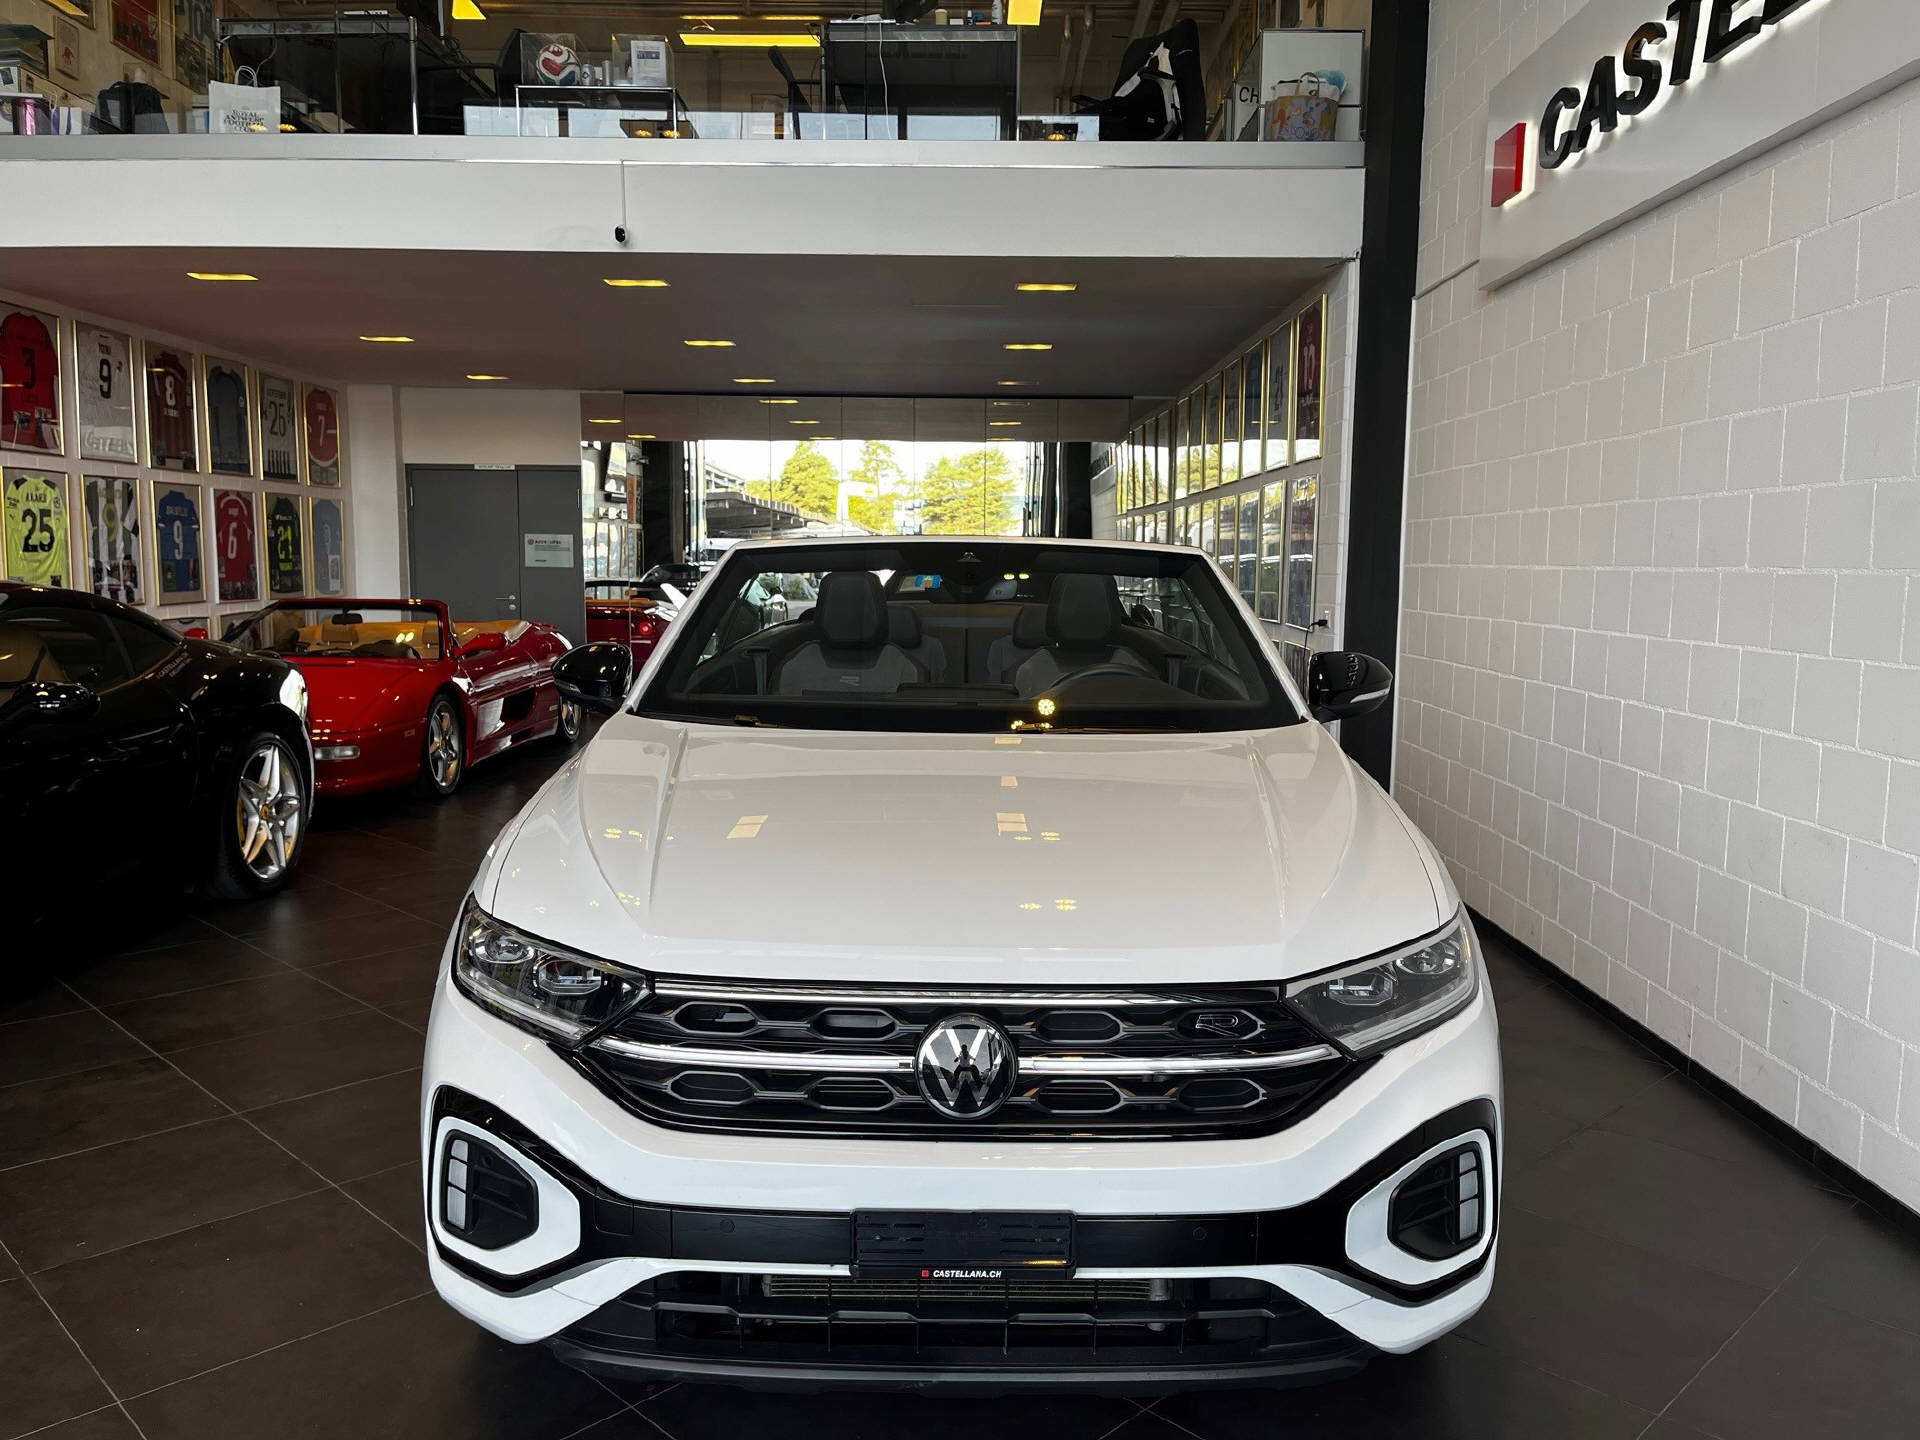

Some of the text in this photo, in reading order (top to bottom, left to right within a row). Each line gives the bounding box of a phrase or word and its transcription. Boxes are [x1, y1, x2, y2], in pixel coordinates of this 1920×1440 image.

[1538, 0, 1812, 169] CASTE
[232, 109, 257, 117] ROYAL
[99, 358, 112, 399] 9
[165, 375, 176, 406] 8
[22, 508, 55, 552] 25
[102, 502, 119, 543] 9
[173, 520, 183, 560] 9
[227, 521, 237, 559] 6
[933, 1270, 1002, 1278] CASTELLANA.CH
